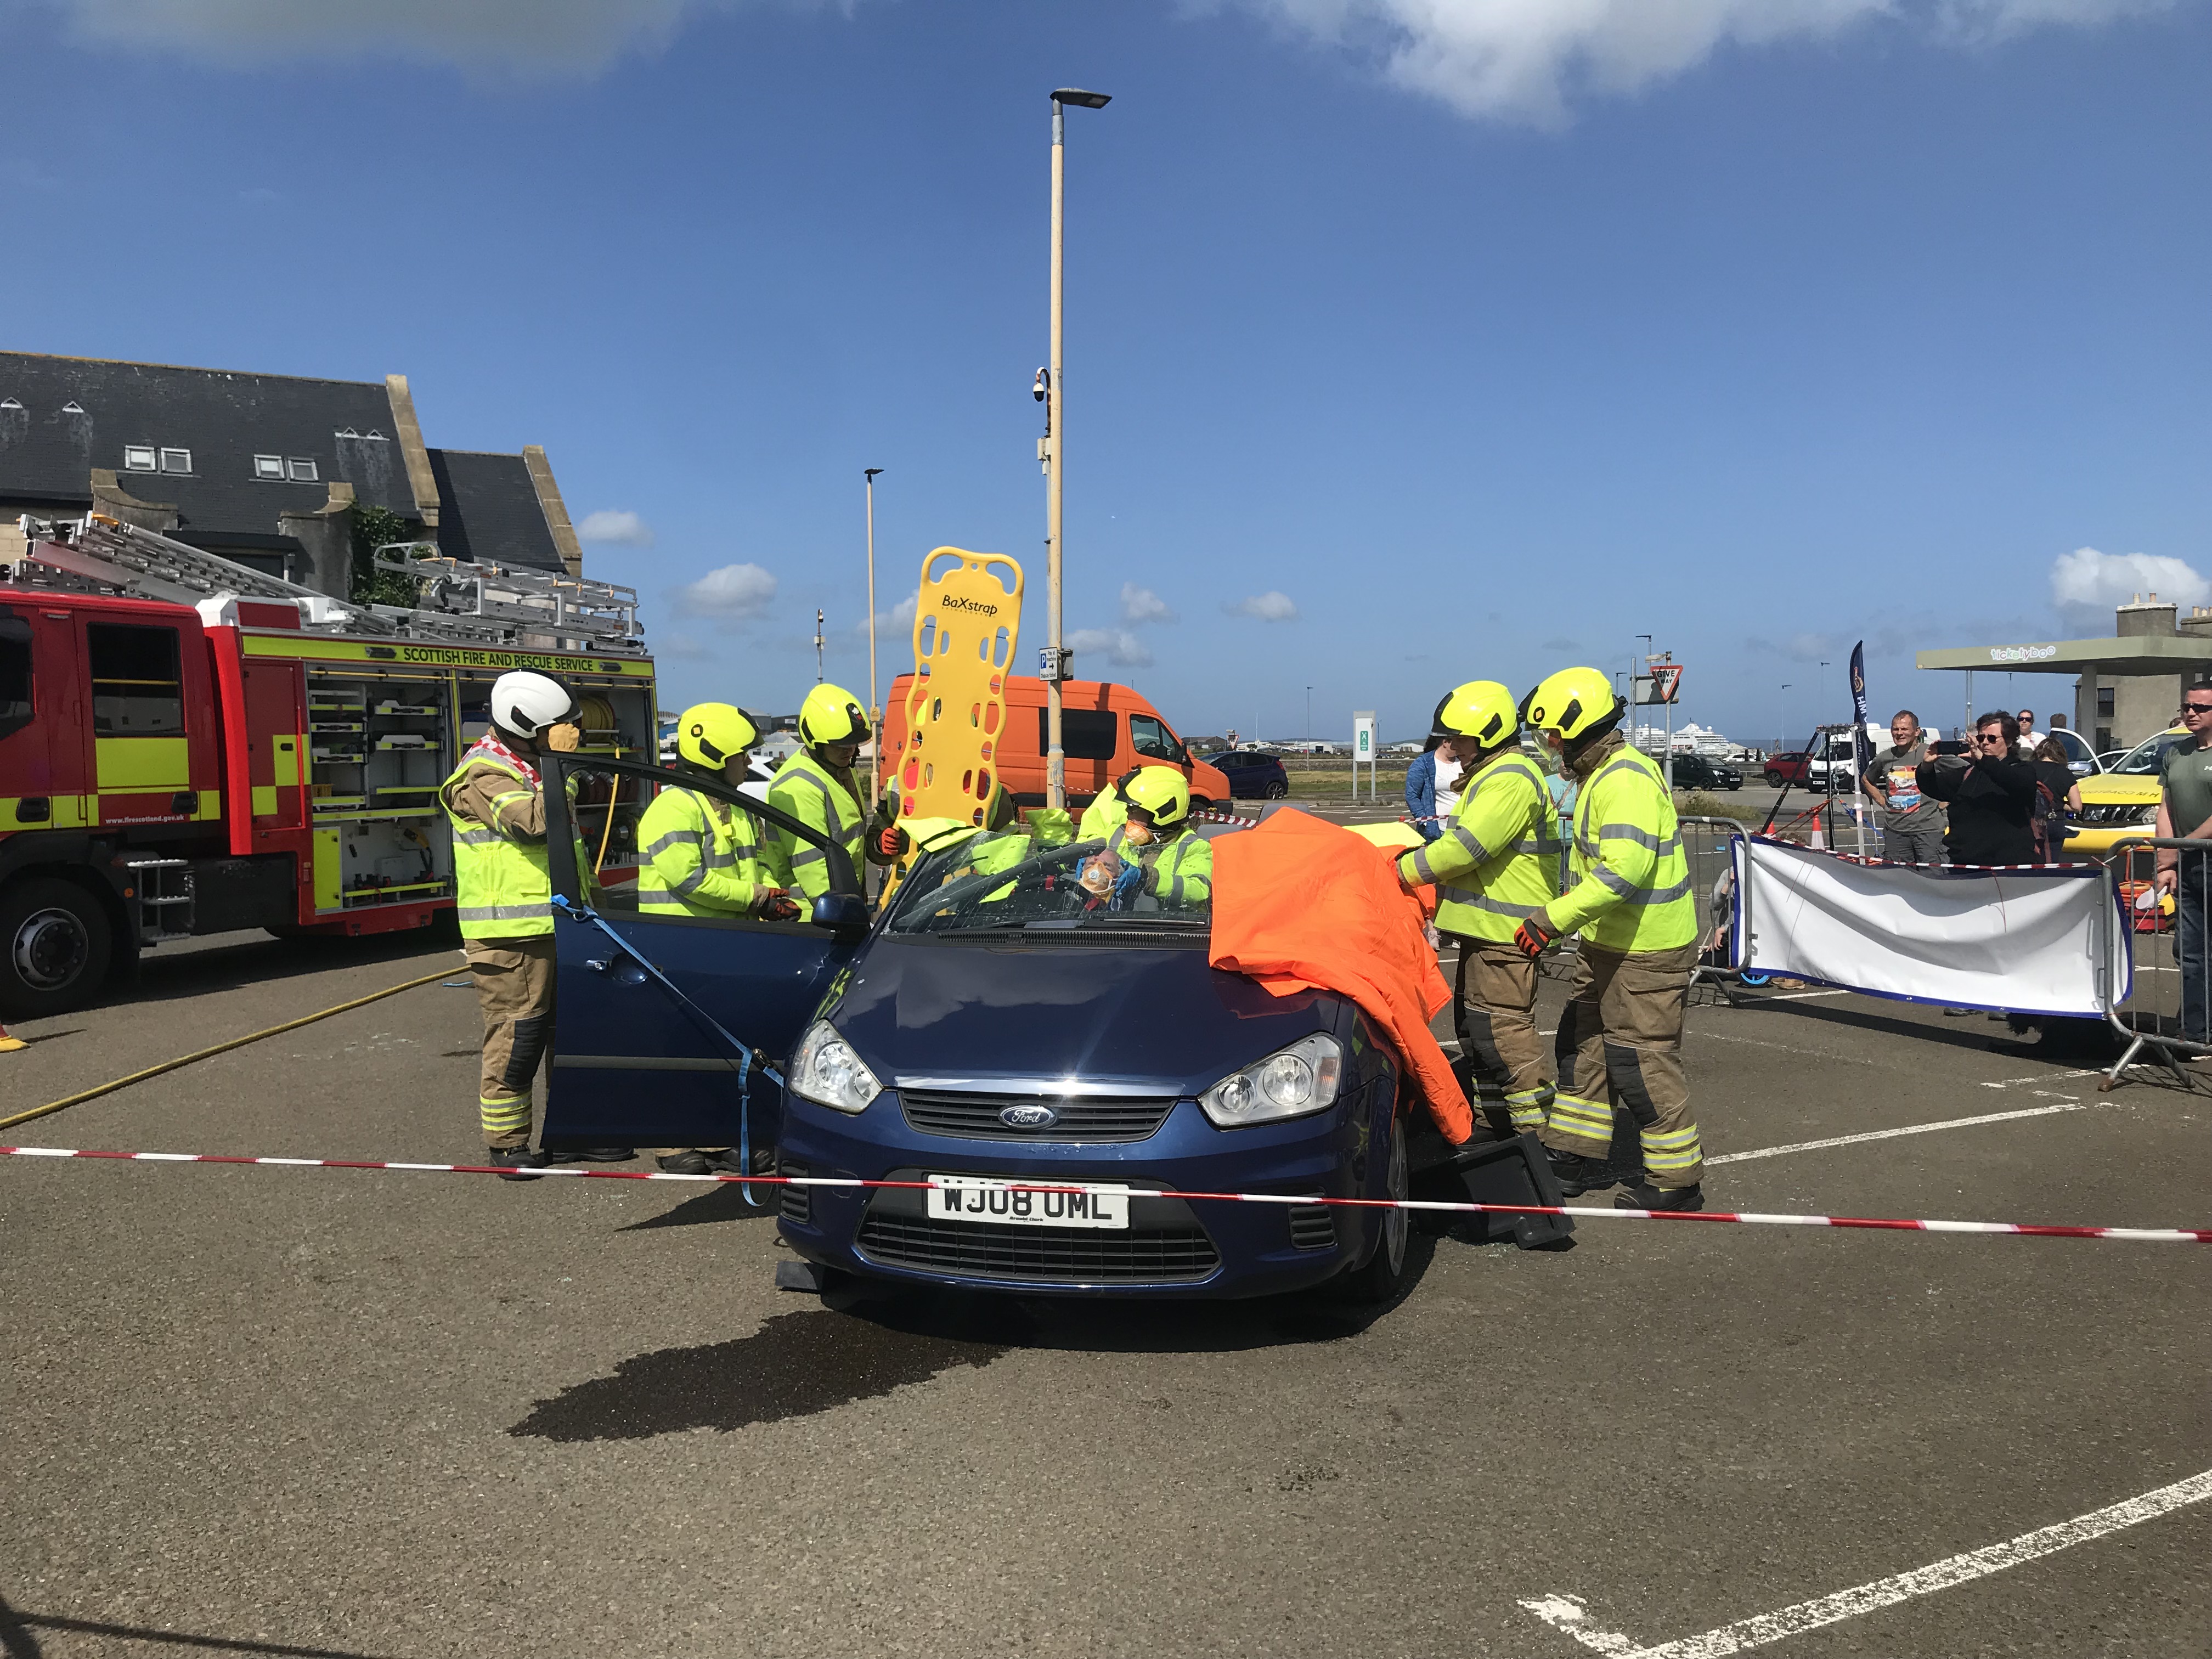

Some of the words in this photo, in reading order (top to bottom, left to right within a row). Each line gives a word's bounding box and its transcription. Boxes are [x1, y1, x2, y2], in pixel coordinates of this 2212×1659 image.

[942, 595, 998, 617] BaXstrap
[404, 648, 460, 663] SCOTTISH
[462, 651, 486, 664] FIRE
[489, 653, 512, 666] AND
[514, 654, 552, 669] RESCUE
[555, 657, 593, 672] SERVICE
[1041, 655, 1046, 668] P
[1857, 696, 1867, 714] HM
[105, 814, 184, 824] www.firescotland.gov.uk
[1011, 1109, 1041, 1123] Ford
[944, 1178, 1032, 1216] WJ08
[1044, 1184, 1112, 1220] UML
